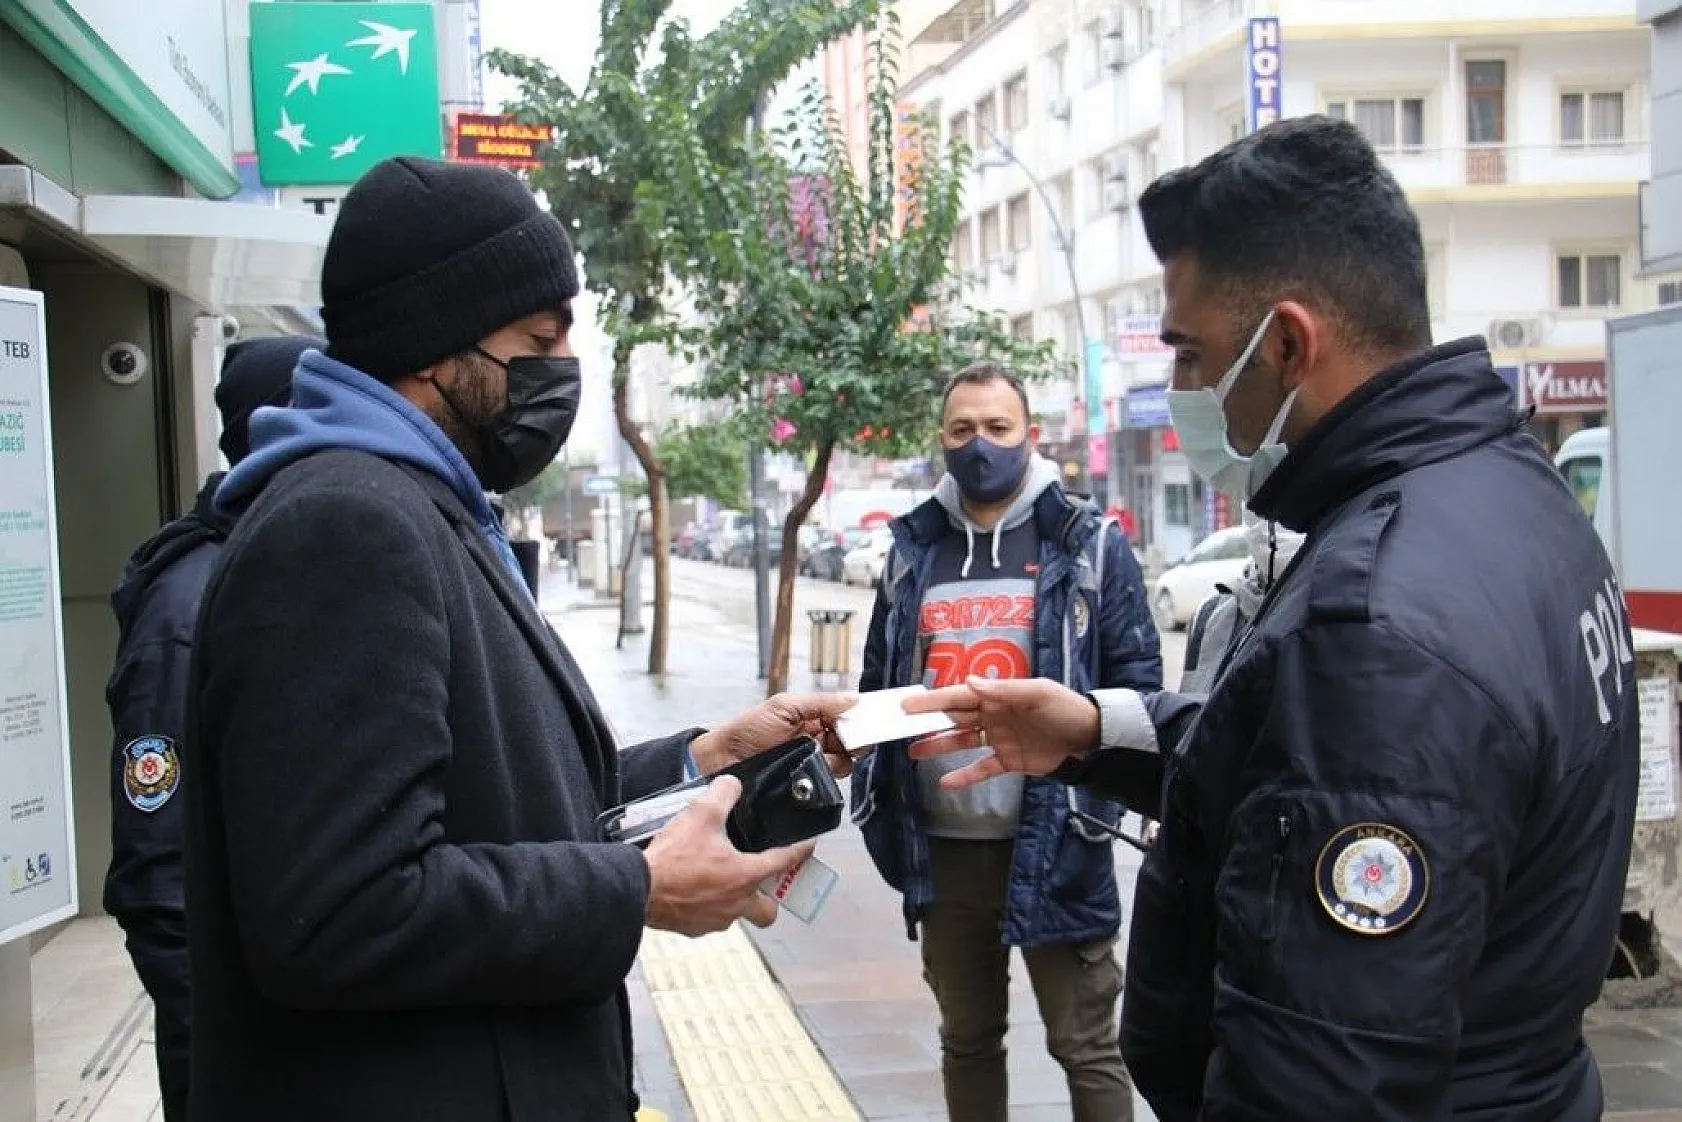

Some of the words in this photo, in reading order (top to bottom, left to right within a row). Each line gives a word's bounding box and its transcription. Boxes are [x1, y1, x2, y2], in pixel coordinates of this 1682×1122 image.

[1252, 21, 1279, 131] HOTE
[3, 340, 30, 358] TEB
[1528, 364, 1607, 404] YILMA
[1579, 577, 1634, 724] POL
